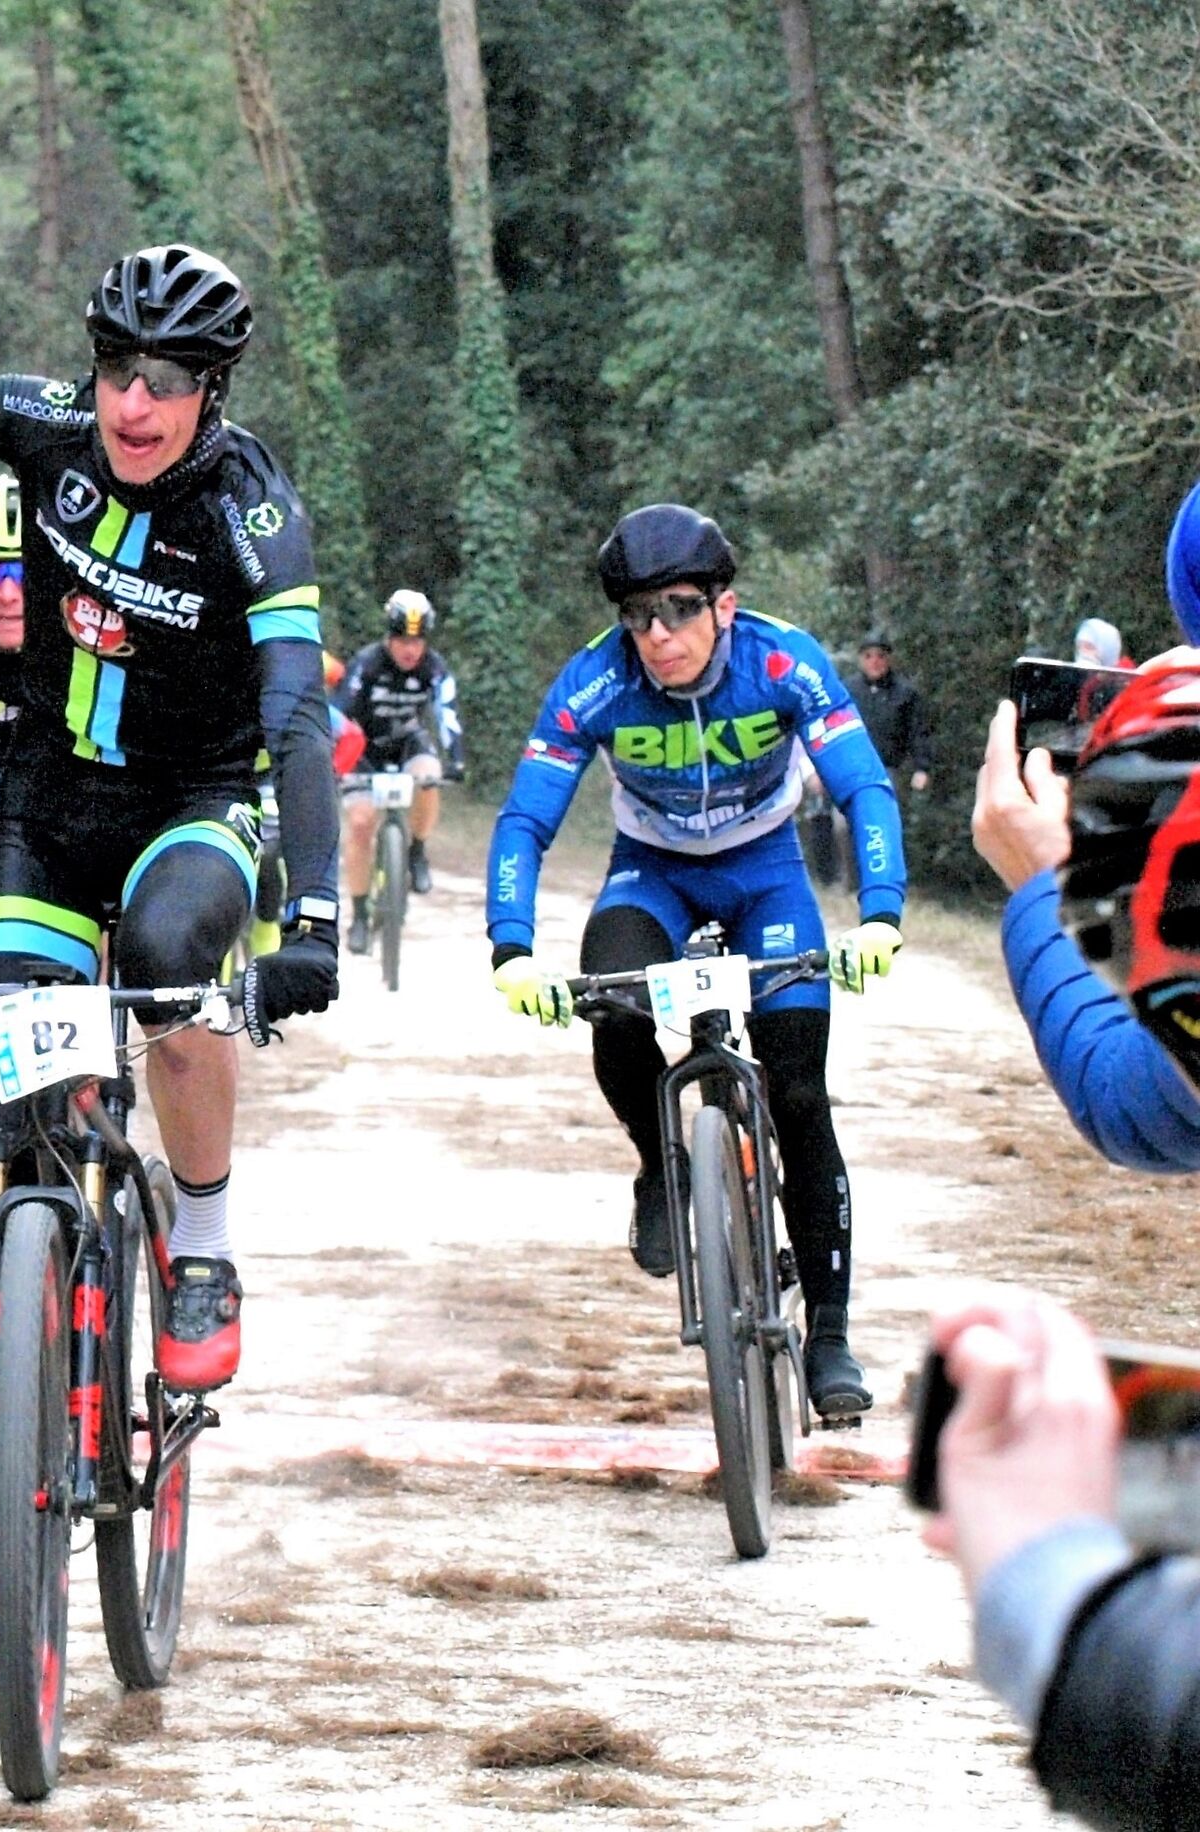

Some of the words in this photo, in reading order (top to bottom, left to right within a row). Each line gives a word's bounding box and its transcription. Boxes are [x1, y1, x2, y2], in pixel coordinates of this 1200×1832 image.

[3, 393, 97, 424] MARCOCAVIN
[613, 710, 786, 770] BIKE
[696, 968, 711, 990] 5
[31, 1020, 79, 1056] 82
